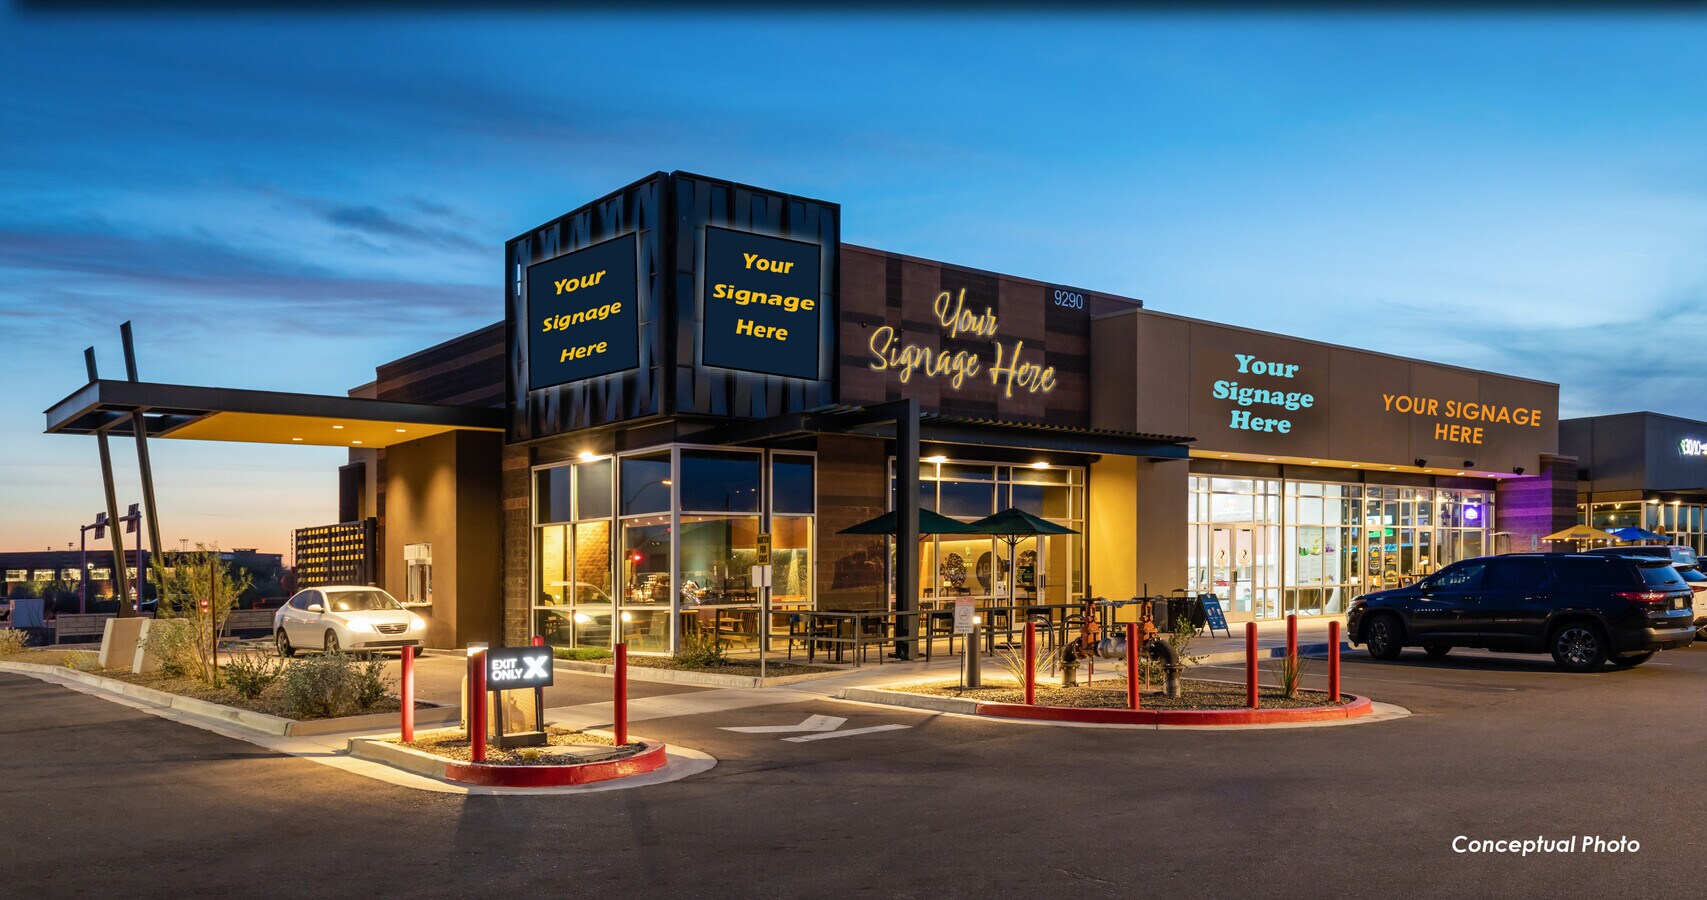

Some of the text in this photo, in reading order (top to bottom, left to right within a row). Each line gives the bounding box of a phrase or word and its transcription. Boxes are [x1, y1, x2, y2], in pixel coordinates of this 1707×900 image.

[743, 252, 794, 274] Your
[554, 270, 606, 295] Your
[712, 283, 815, 312] Signage
[1054, 290, 1083, 310] 9290
[542, 301, 622, 332] Signage
[934, 288, 998, 338] Your
[735, 319, 788, 341] Here
[559, 341, 608, 363] Here
[870, 326, 1057, 397] Signage Here
[1235, 354, 1299, 378] Your
[1212, 380, 1315, 412] Signage
[1229, 409, 1292, 434] Here
[1382, 394, 1542, 427] YOUR SIGNAGE
[1434, 423, 1484, 445] HERE
[492, 658, 518, 670] EXIT
[492, 669, 523, 680] ONLY
